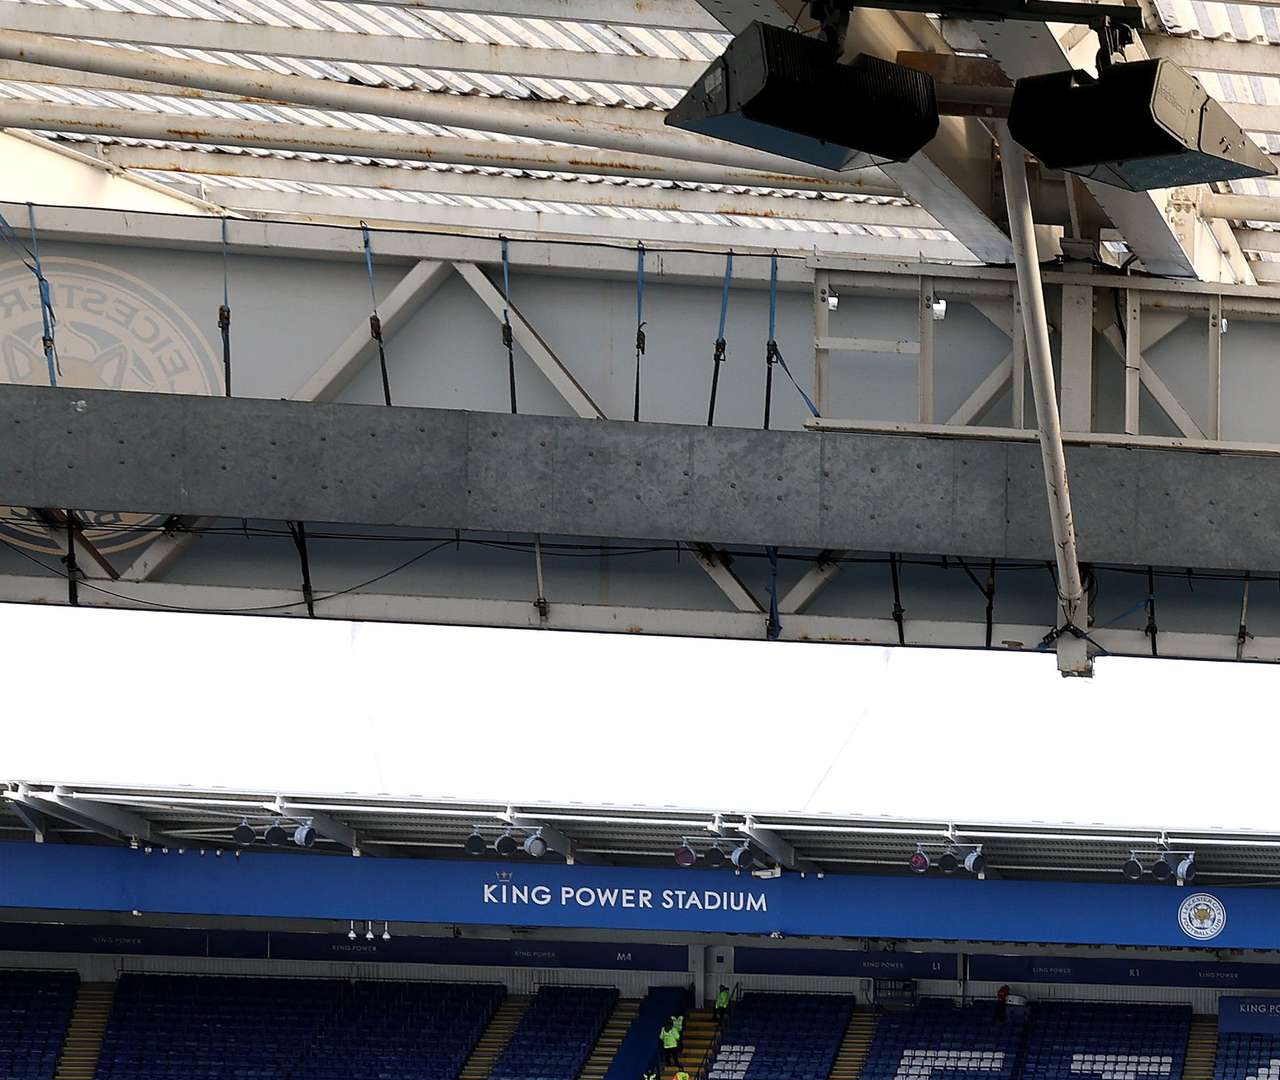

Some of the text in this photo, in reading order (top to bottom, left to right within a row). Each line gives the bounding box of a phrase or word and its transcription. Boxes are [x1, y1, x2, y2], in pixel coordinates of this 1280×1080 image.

[484, 885, 767, 912] KING POWER STADIUM
[617, 953, 632, 961] M4
[1240, 1005, 1266, 1013] KING
